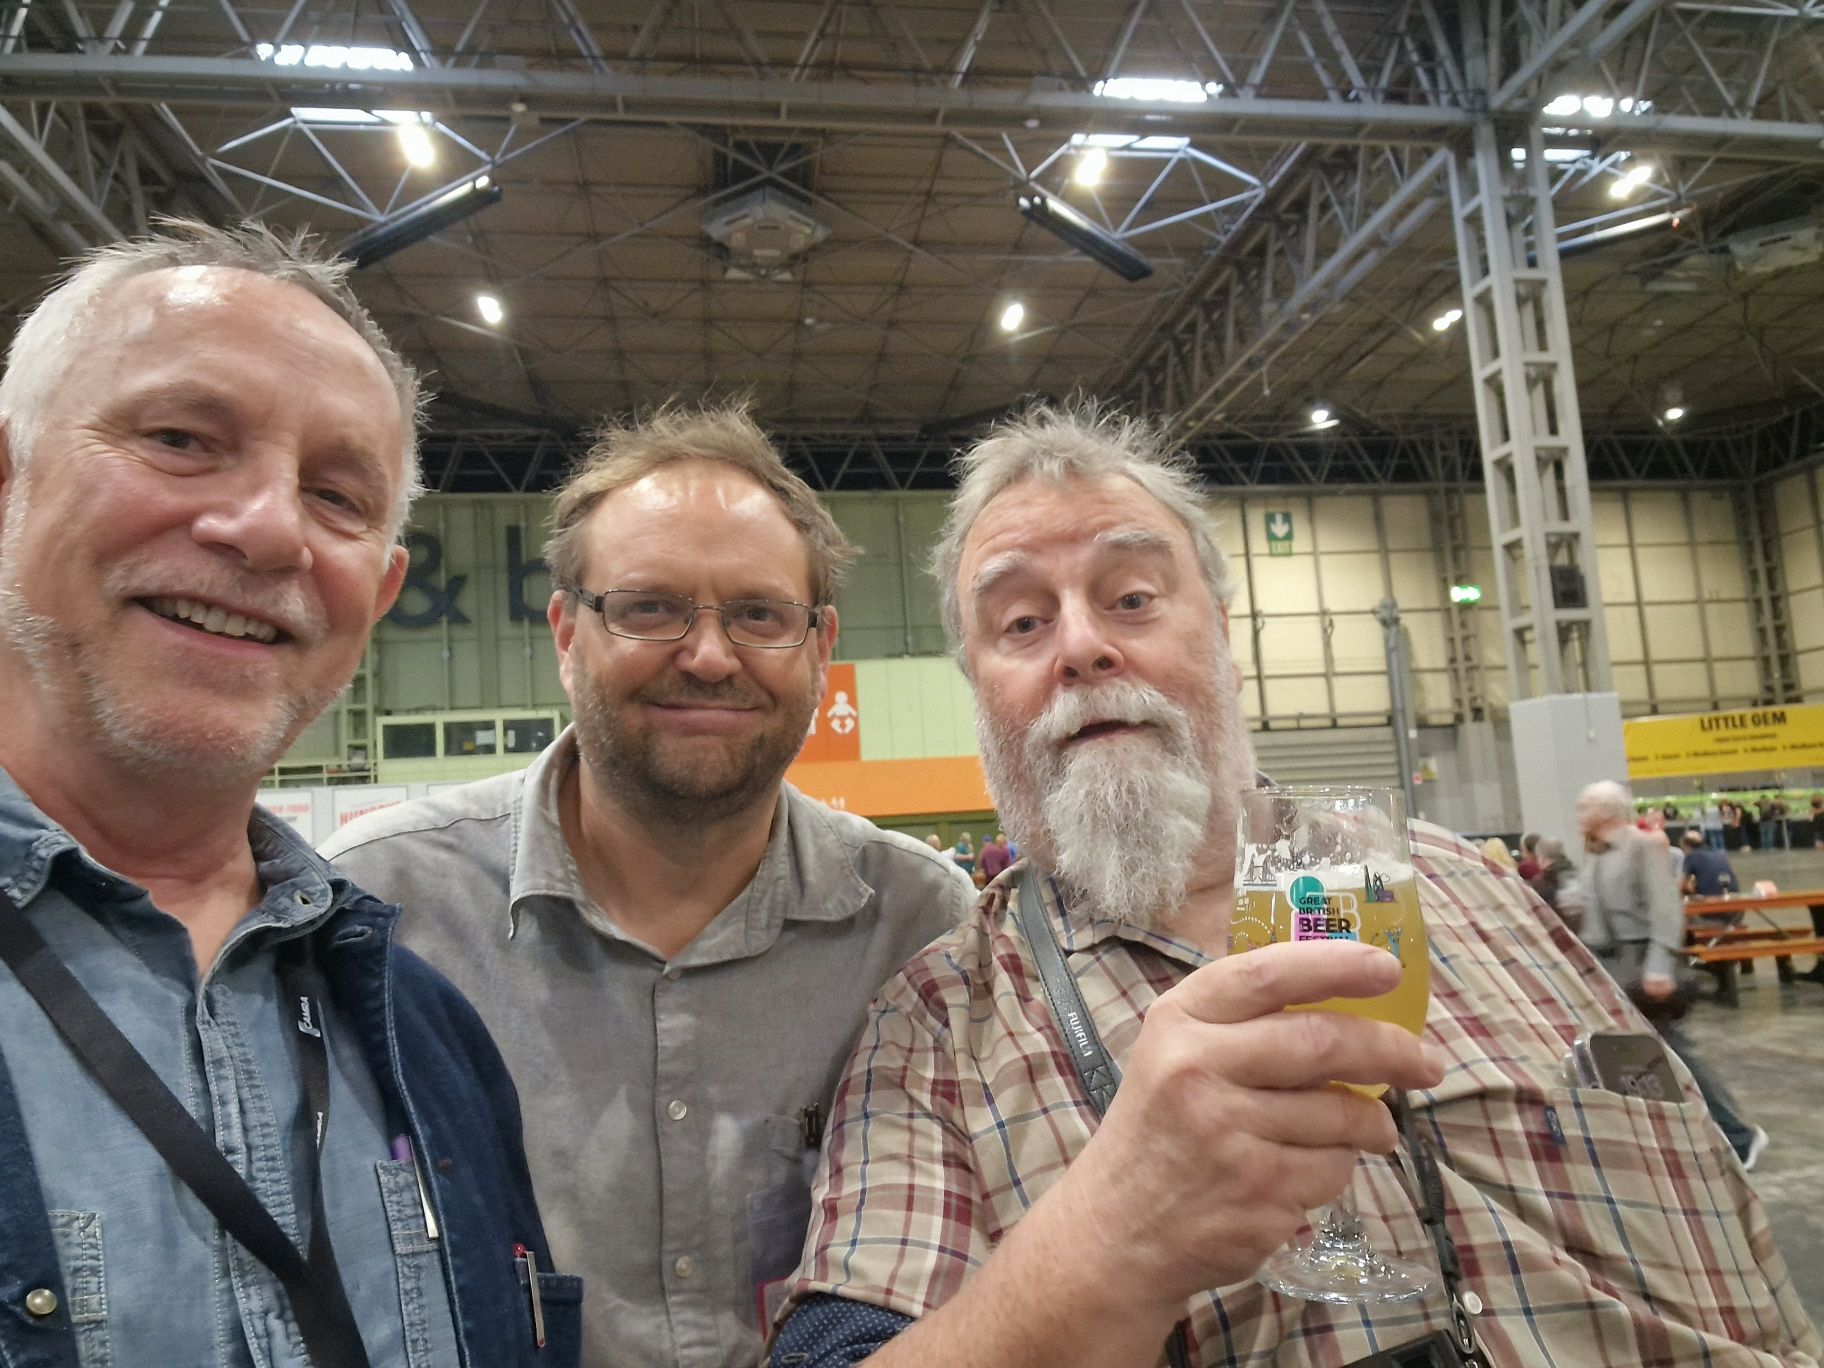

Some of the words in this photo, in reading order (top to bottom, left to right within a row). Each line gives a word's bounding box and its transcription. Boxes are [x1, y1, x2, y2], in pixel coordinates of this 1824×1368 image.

[1700, 713, 1746, 732] LITTLE
[1751, 711, 1787, 728] GEM
[1299, 897, 1331, 905] GREAT
[1298, 907, 1339, 915] BRITISH
[1298, 917, 1352, 934] BEER
